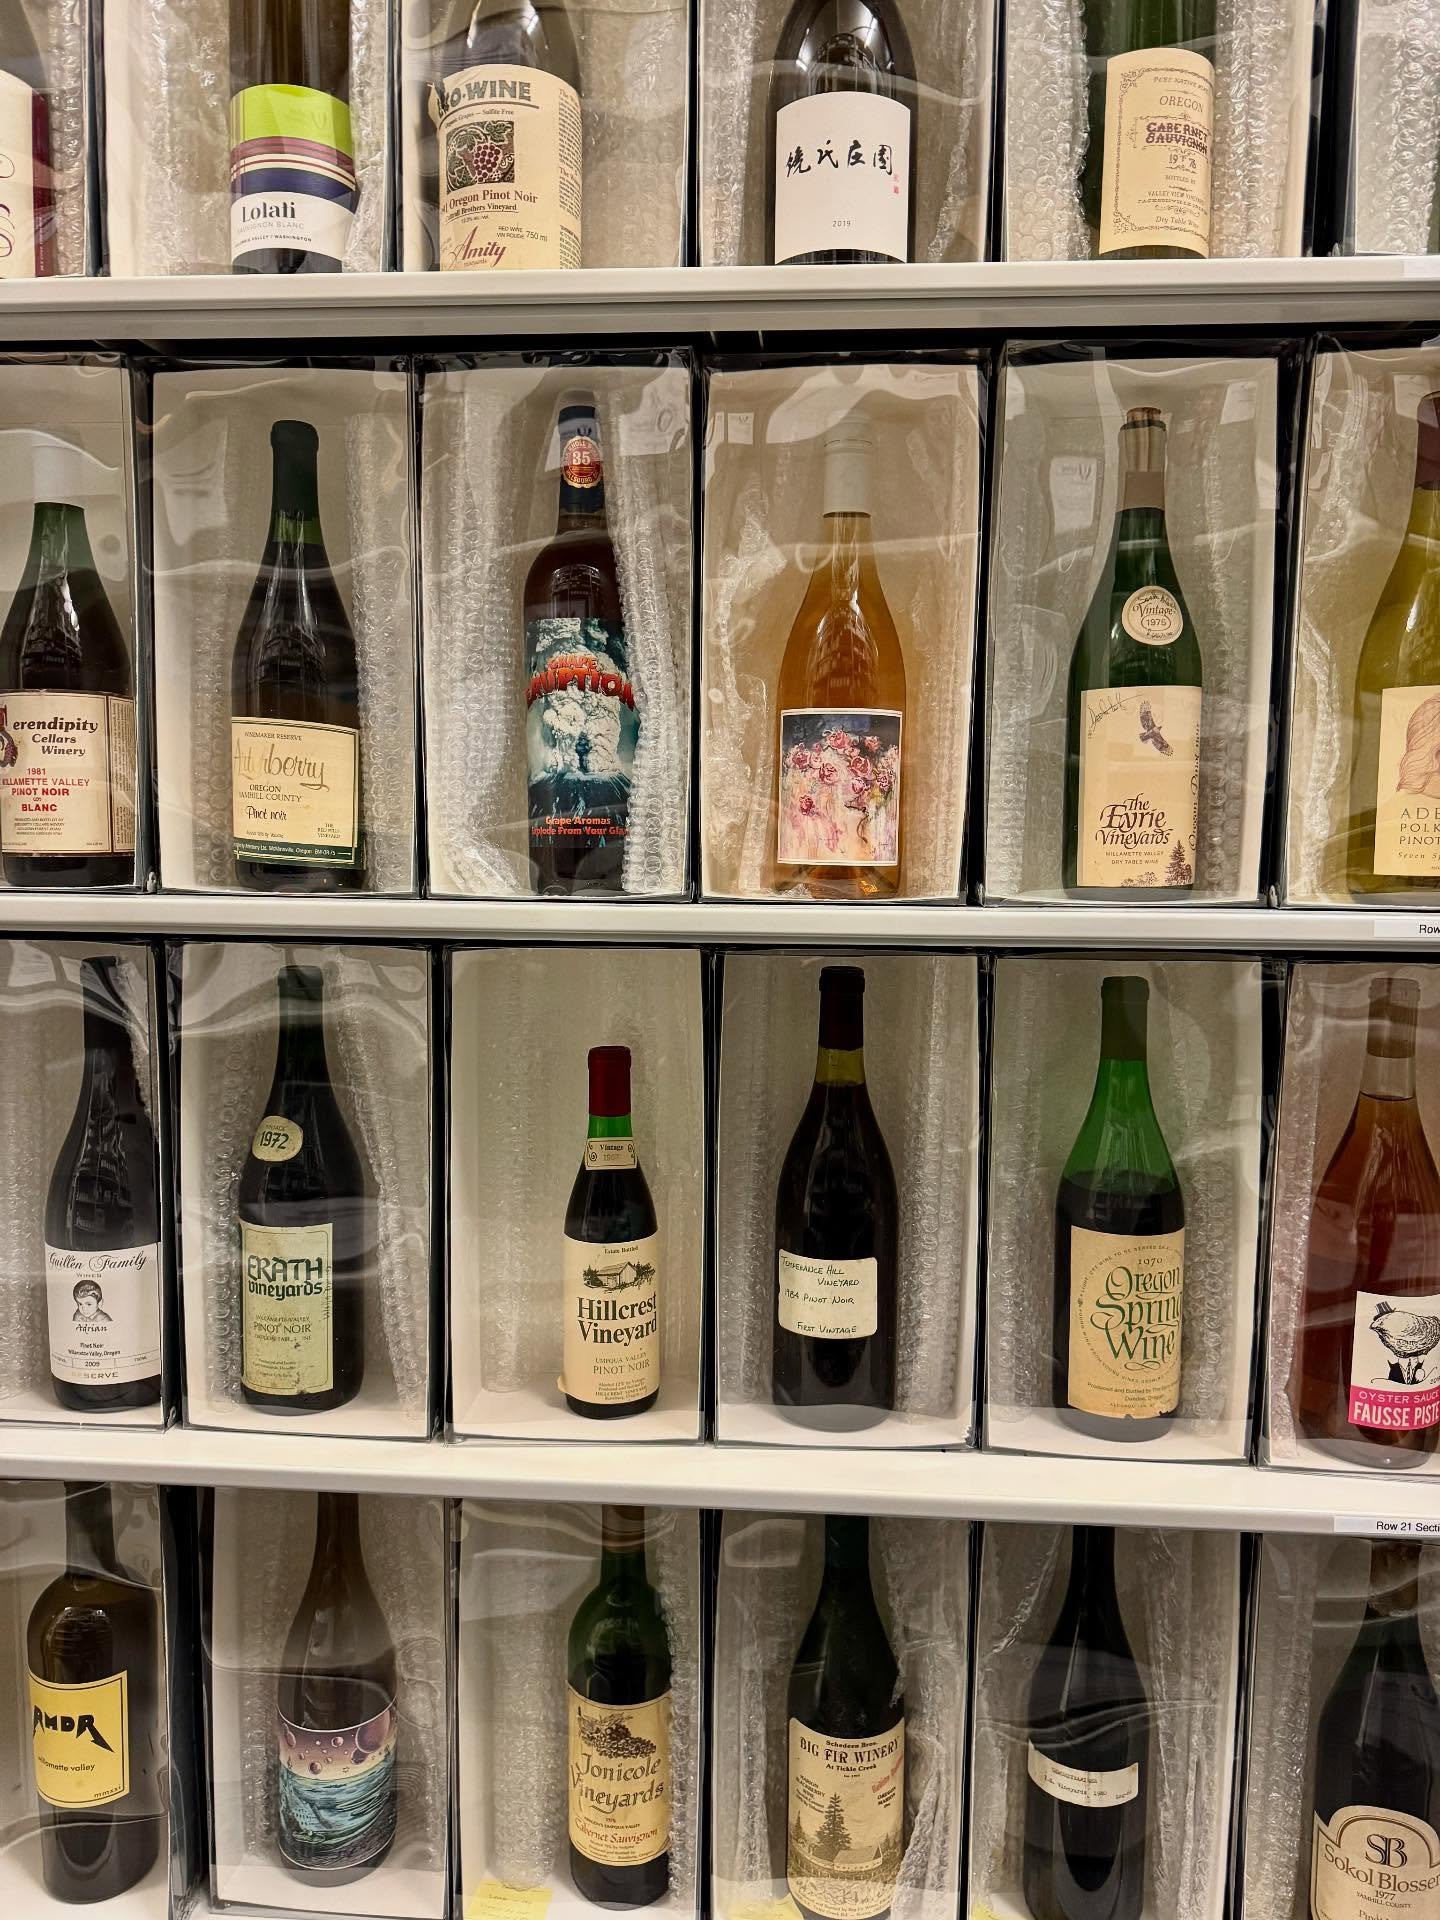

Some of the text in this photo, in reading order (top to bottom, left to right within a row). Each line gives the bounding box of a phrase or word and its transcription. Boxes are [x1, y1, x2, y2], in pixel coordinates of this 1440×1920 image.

[1160, 95, 1203, 113] OREGON
[1146, 122, 1208, 142] CABERNET
[1145, 132, 1208, 154] SAUVIGNON
[450, 189, 538, 209] Oregon Pinot Noir
[461, 202, 517, 214] Brothers Vineyard
[238, 220, 304, 233] AUVIGNON BLANC
[832, 220, 851, 228] 2019
[1156, 215, 1187, 224] Dry Table
[274, 234, 312, 242] WASHINGTON
[526, 230, 539, 240] 750
[450, 225, 507, 268] Amity
[1132, 602, 1174, 618] Vintage
[32, 733, 77, 743] Cellars
[276, 732, 303, 741] RESERVE
[41, 745, 86, 757] Winery
[27, 767, 46, 775] 1981
[51, 778, 90, 787] VALLEY
[249, 783, 282, 793] OREGON
[11, 787, 70, 796] PINOT NOIR
[265, 792, 302, 803] COUNTY
[21, 803, 58, 812] BLANC
[246, 805, 268, 820] Pinot
[545, 815, 612, 827] Grape Aromas
[1100, 804, 1166, 833] Eyrie
[557, 826, 582, 835] From
[585, 826, 607, 835] Your
[1095, 829, 1174, 850] Vineyards
[260, 1130, 290, 1149] 1972
[49, 1250, 147, 1273] Guillen Family
[247, 1254, 323, 1283] ERATH
[780, 1256, 845, 1276] TEMPERANCE HILL
[817, 1278, 860, 1287] VINEYARD
[1105, 1266, 1180, 1300] Oregon
[248, 1280, 323, 1301] vineyards
[577, 1292, 656, 1320] Hillcrest
[803, 1293, 855, 1305] PINOT NOIR
[1090, 1291, 1183, 1334] Spring
[75, 1323, 108, 1335] Adrian
[284, 1324, 312, 1334] NOIR
[578, 1311, 656, 1347] Vineyard
[819, 1325, 857, 1334] VINTAGE
[1104, 1326, 1175, 1364] Wine
[593, 1358, 650, 1375] PINOT NOIR
[1358, 1391, 1409, 1404] OYSTER
[1354, 1400, 1411, 1427] FAUSSE
[1376, 1521, 1399, 1531] Row
[1400, 1522, 1412, 1531] 21
[800, 1736, 819, 1757] BIG
[824, 1748, 848, 1764] FIR
[70, 1763, 96, 1772] valley
[575, 1753, 661, 1782] Jonicole
[570, 1765, 664, 1814] Vineyards
[575, 1818, 658, 1845] Cabernet Sauvignon
[1324, 1843, 1375, 1887] Sokol
[1356, 1891, 1412, 1909] YAMHILL COUNTY
[1374, 1890, 1397, 1901] 1977
